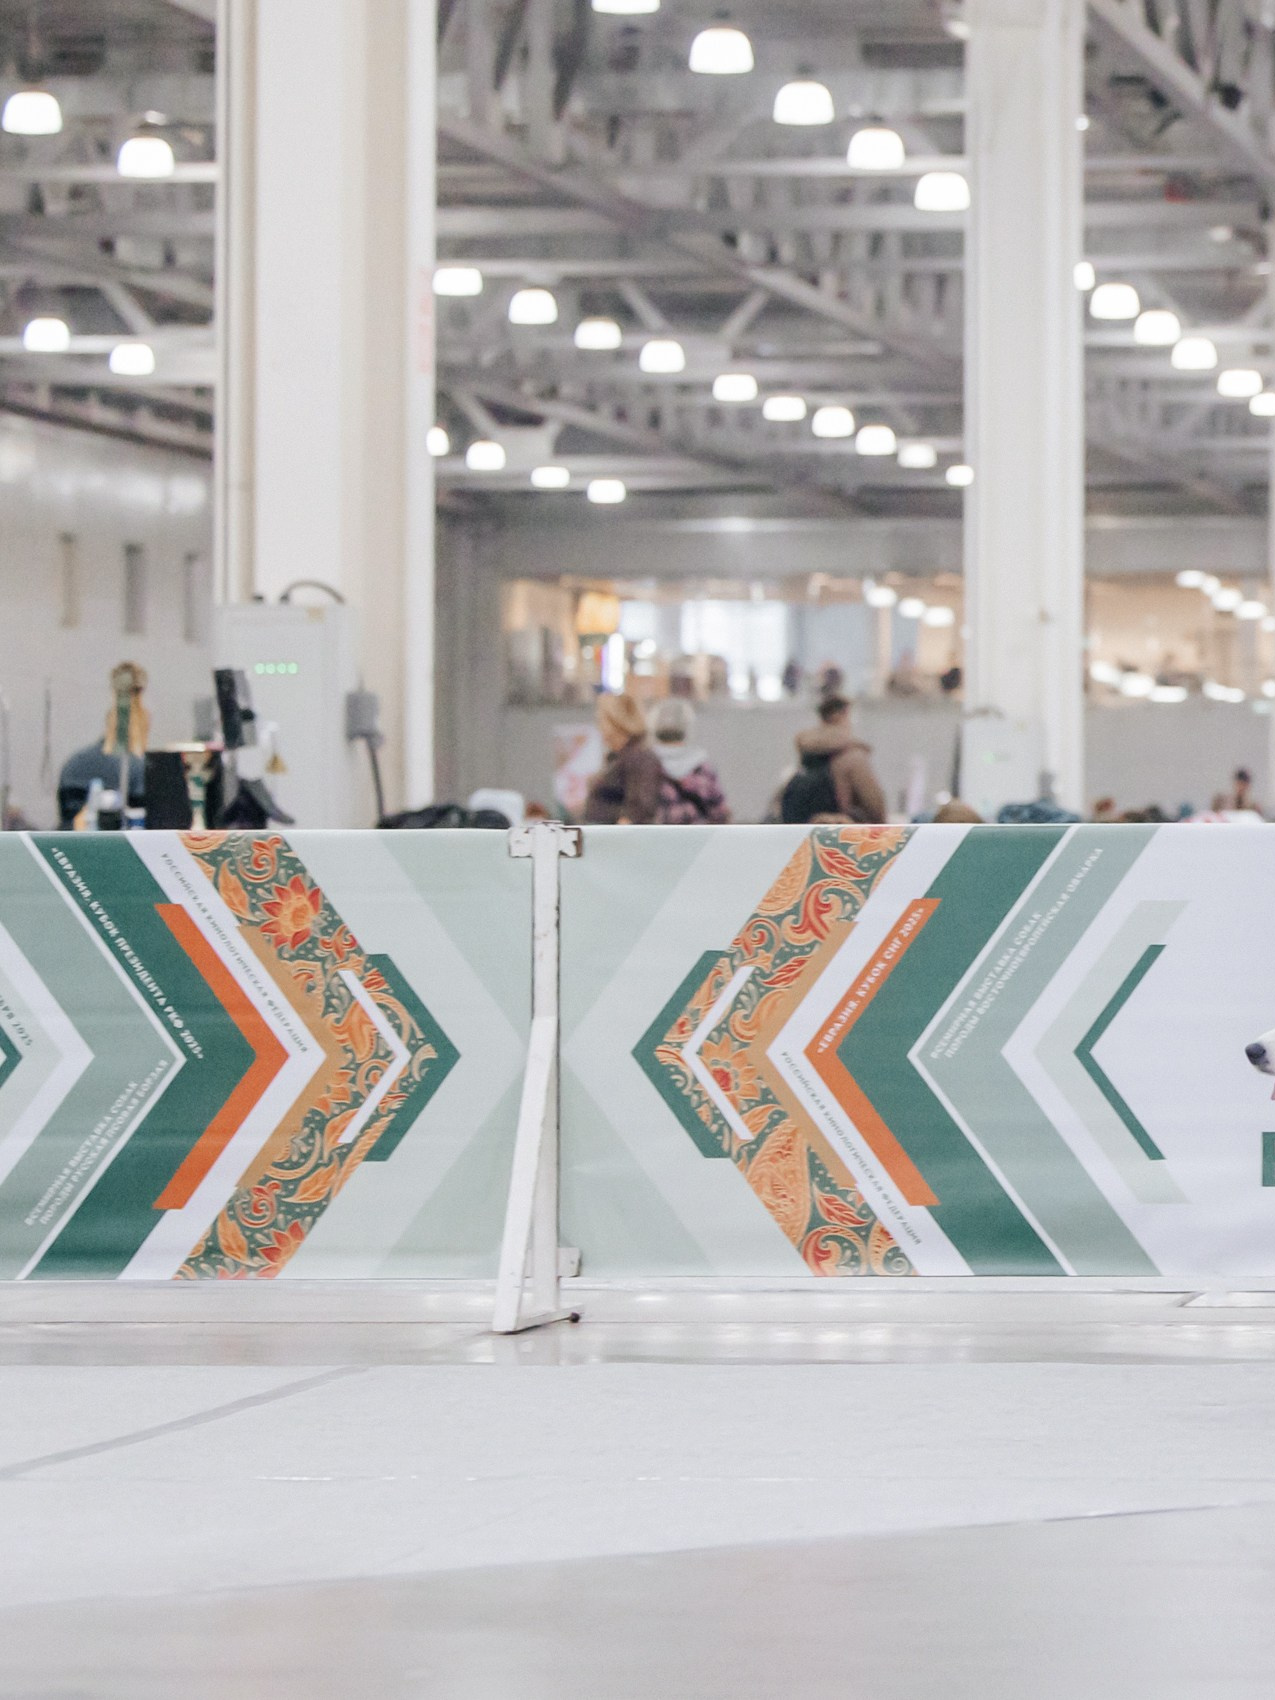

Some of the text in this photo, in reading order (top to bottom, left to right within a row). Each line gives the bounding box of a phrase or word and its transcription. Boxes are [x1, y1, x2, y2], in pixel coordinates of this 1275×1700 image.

[89, 900, 120, 938] КУБОК
[115, 937, 168, 1006] ПРЕЗИДЕНТА
[163, 1005, 184, 1029] РКФ
[160, 852, 308, 1053] РОССИЙСКАЯ КИНОЛОГИЧЕСКАЯ ФЕДЕРАЦИЯ
[855, 961, 887, 998] КУБОК
[883, 937, 903, 961] СНГ
[973, 947, 1016, 1000] ВЫСТАВКА
[1013, 913, 1043, 946] СОБАК
[11, 1022, 33, 1046] 2025
[943, 1015, 980, 1058] ПОРОДЫ
[135, 1058, 169, 1098] БОРЗАЯ
[68, 1116, 112, 1167] ВЫСТАВКА
[110, 1080, 138, 1114] СОБАК
[781, 1050, 922, 1246] РОССИЙСКАЯ КИНОЛОГИЧЕСКАЯ ФЕДЕРАЦИЯ
